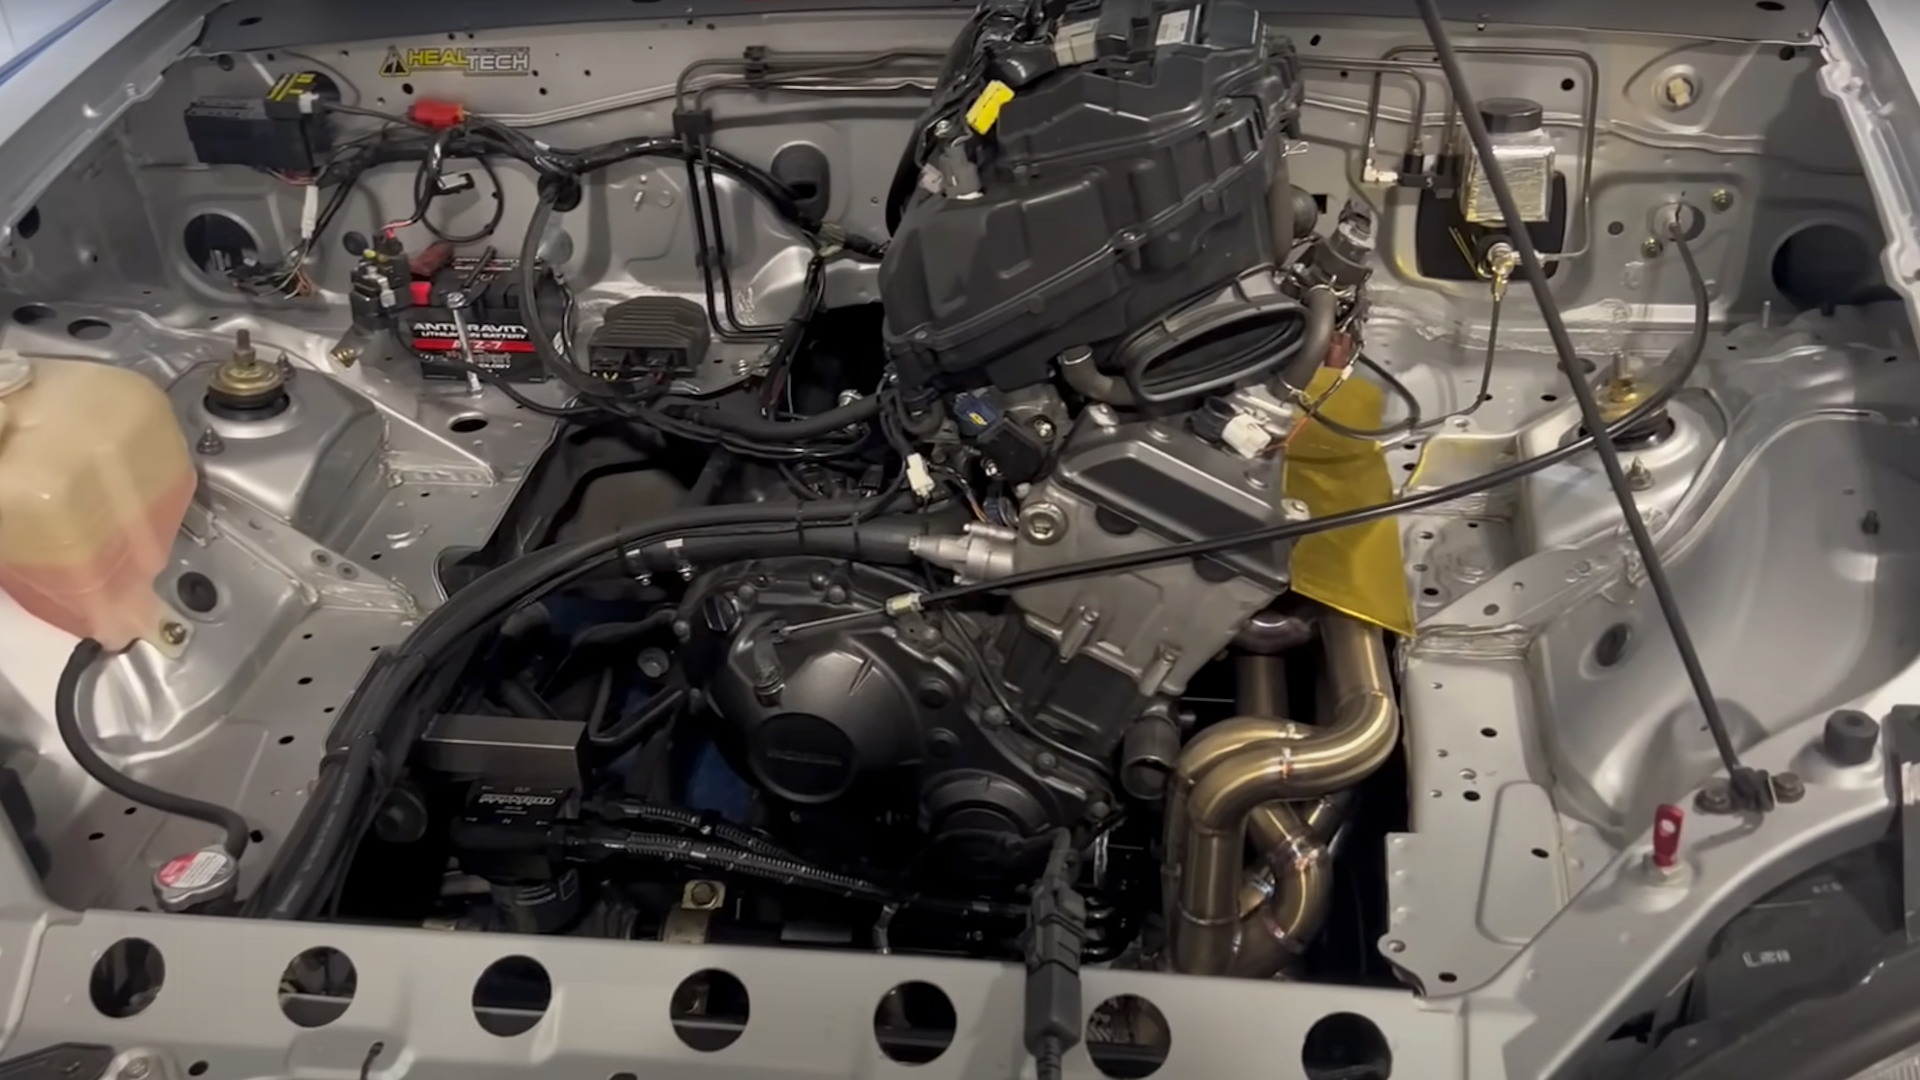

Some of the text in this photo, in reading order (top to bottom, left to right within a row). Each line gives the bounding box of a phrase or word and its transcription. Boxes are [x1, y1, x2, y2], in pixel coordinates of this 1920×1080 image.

[408, 48, 529, 71] HEALTECH
[413, 322, 529, 334] ANTIRAVITY
[451, 339, 503, 350] AZ-7
